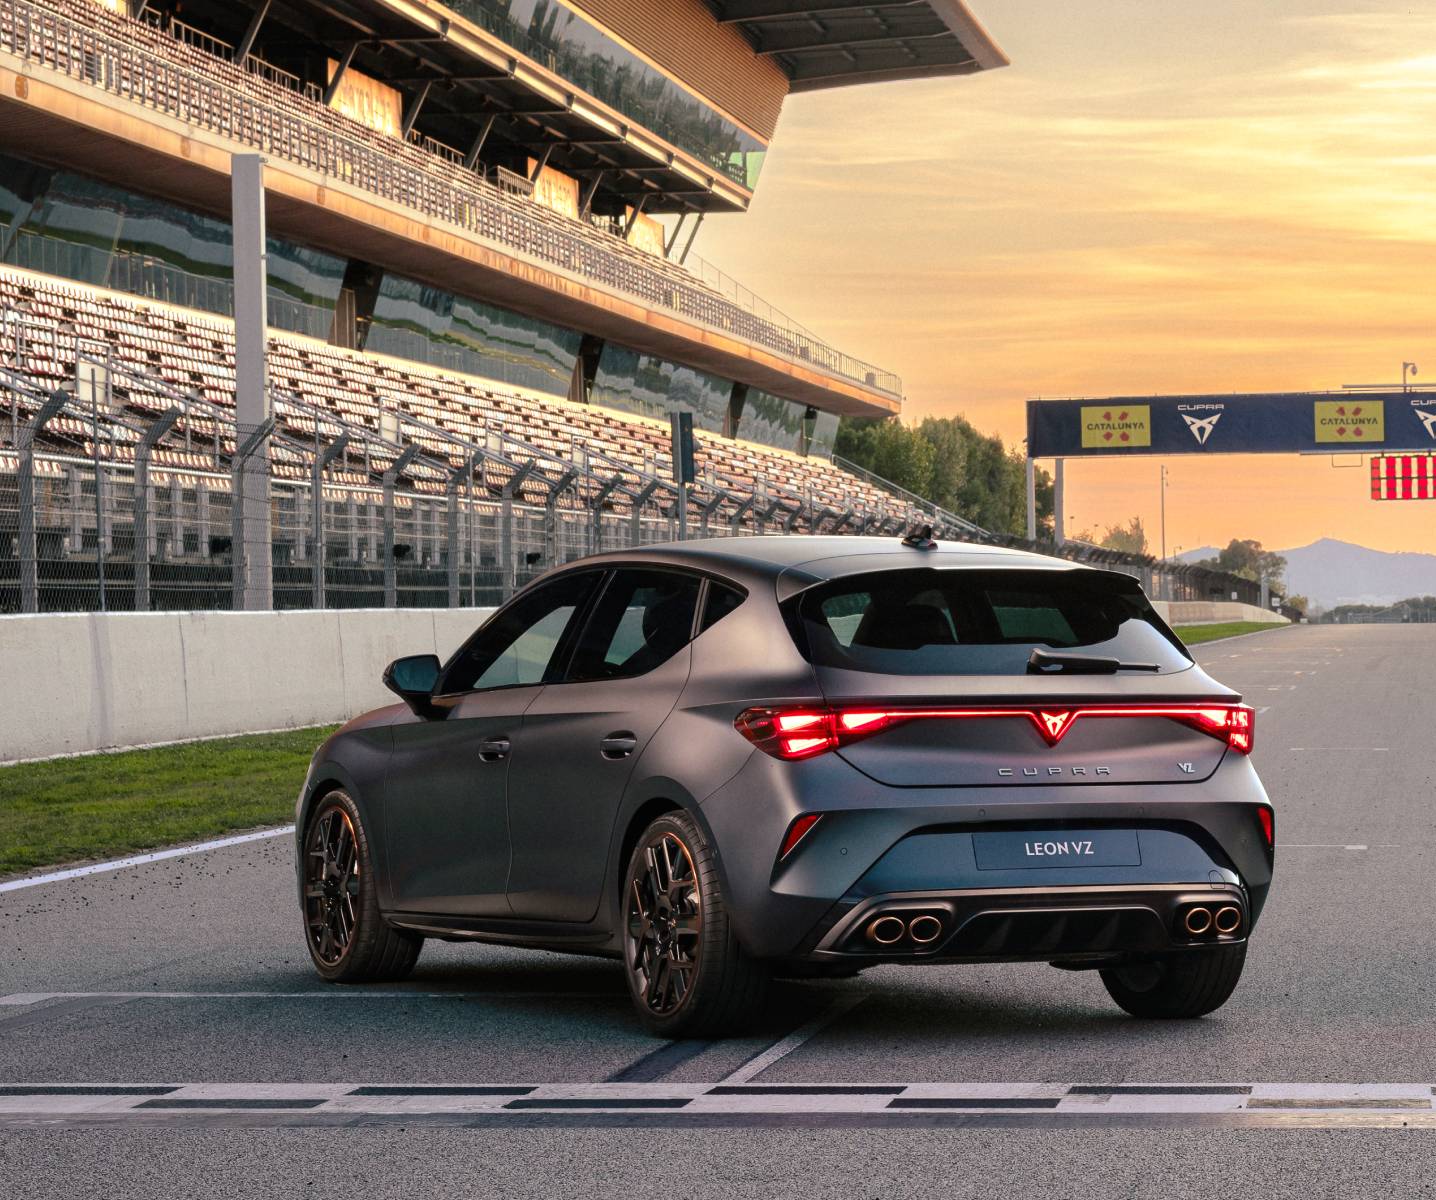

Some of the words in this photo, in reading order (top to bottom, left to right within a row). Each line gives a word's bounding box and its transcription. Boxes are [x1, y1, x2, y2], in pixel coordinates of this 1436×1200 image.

[1177, 403, 1225, 411] CUPRA
[1320, 417, 1378, 426] CATALUNYA
[1086, 422, 1145, 431] CATALUNYA
[998, 766, 1111, 776] CUPRA
[1177, 762, 1196, 773] VZ
[1025, 841, 1069, 856] LEON
[1071, 841, 1094, 855] VZ
